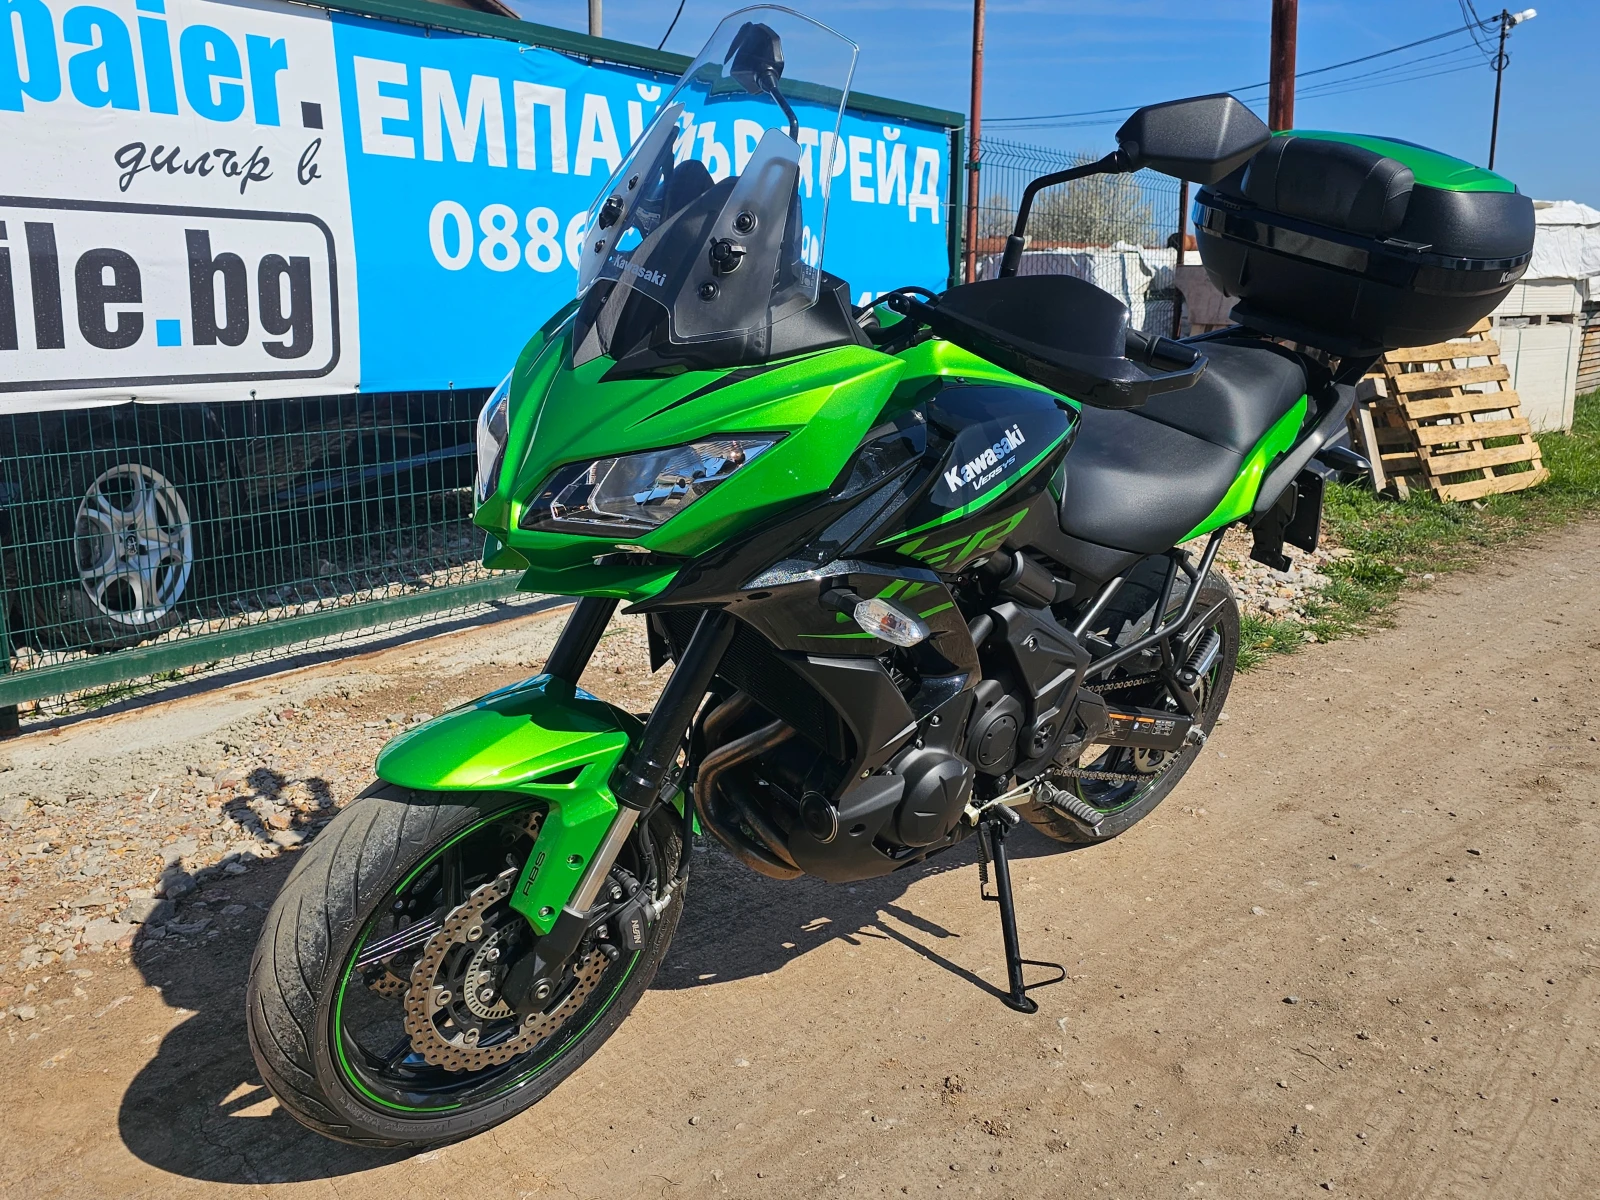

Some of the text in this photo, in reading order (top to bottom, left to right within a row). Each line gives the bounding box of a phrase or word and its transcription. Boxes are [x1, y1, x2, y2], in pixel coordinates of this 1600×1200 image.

[114, 141, 274, 195] дилър
[613, 254, 667, 288] Kawasaki
[943, 423, 1026, 493] Kawasaki
[972, 454, 1016, 491] VERSYS
[522, 851, 547, 897] ABS
